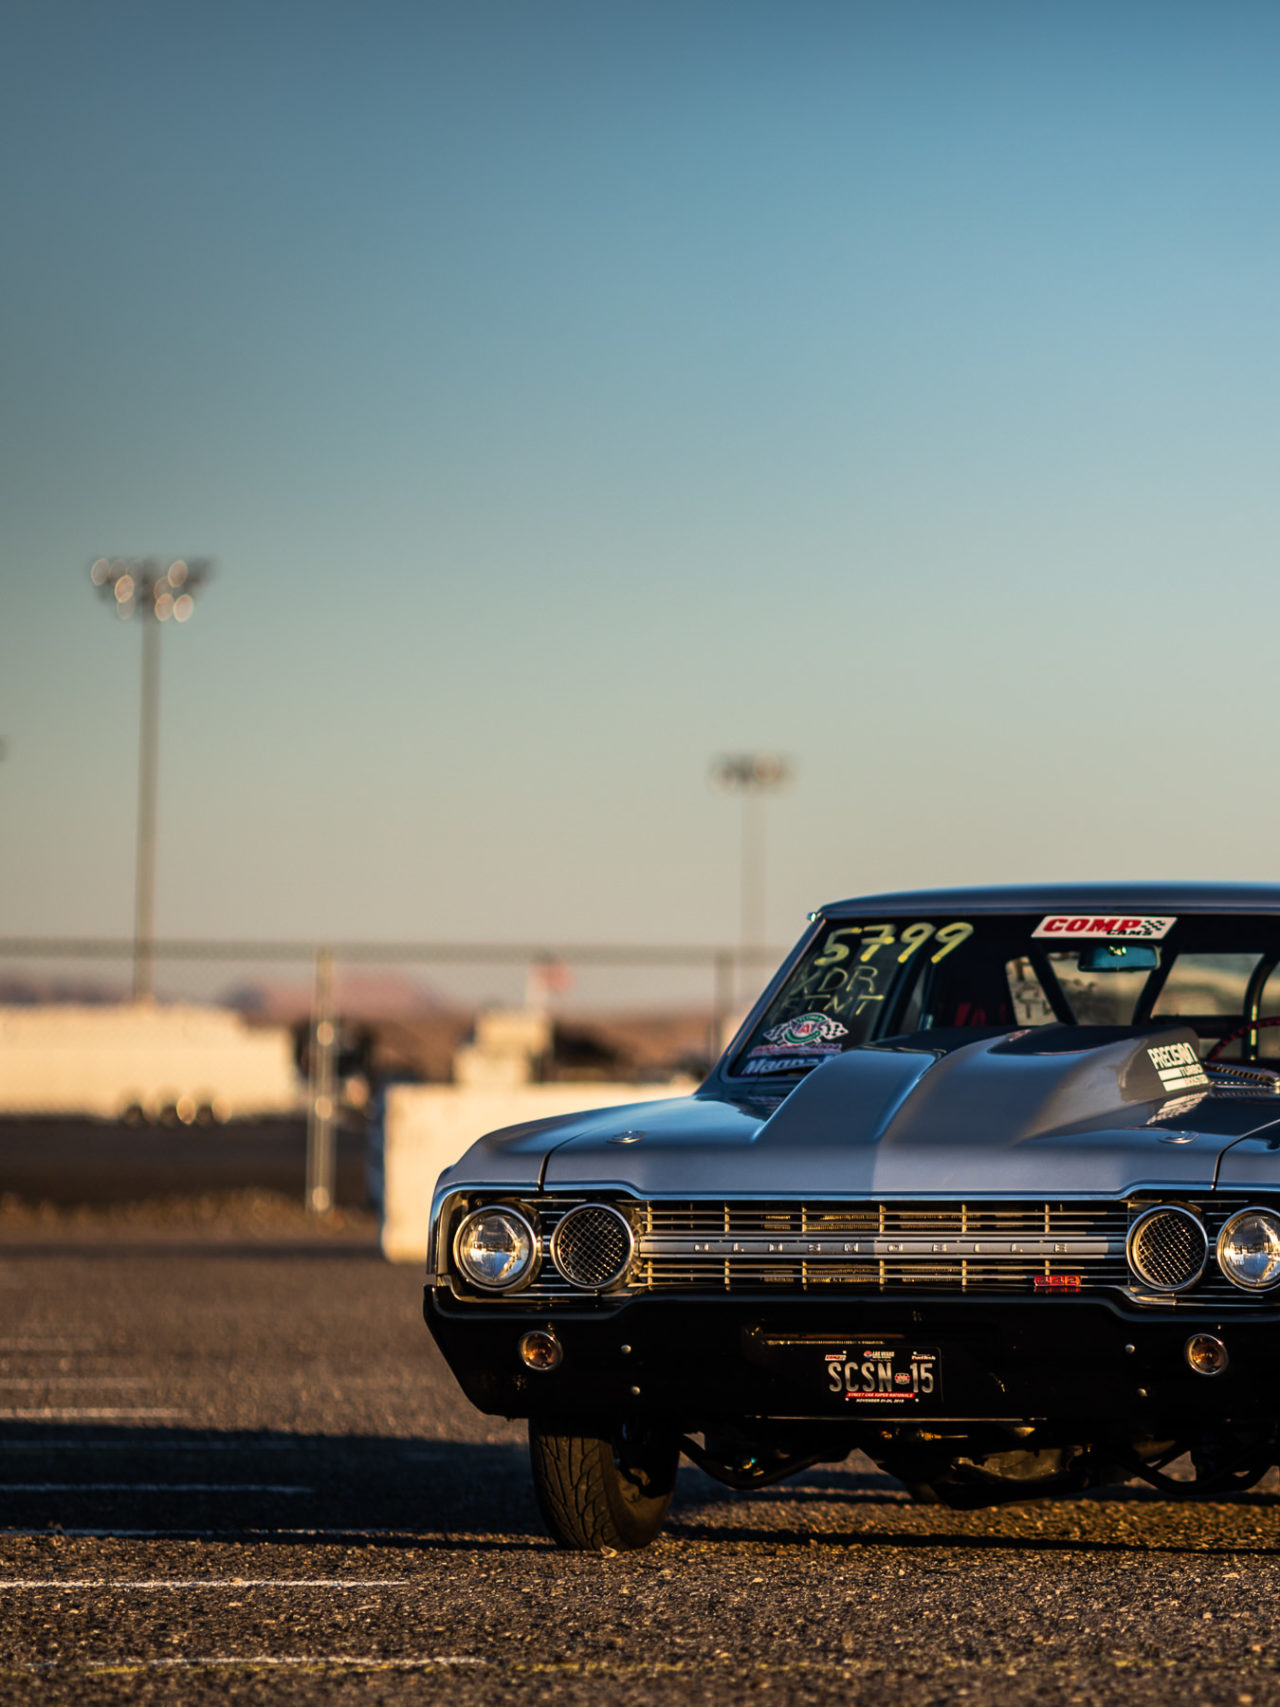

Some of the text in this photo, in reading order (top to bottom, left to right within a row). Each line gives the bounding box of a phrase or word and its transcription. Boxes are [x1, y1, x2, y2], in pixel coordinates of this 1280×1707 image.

[1043, 919, 1142, 933] COMP
[814, 922, 974, 964] 5799
[1147, 1042, 1198, 1070] PRECISION
[827, 1361, 934, 1393] SCSN 15
